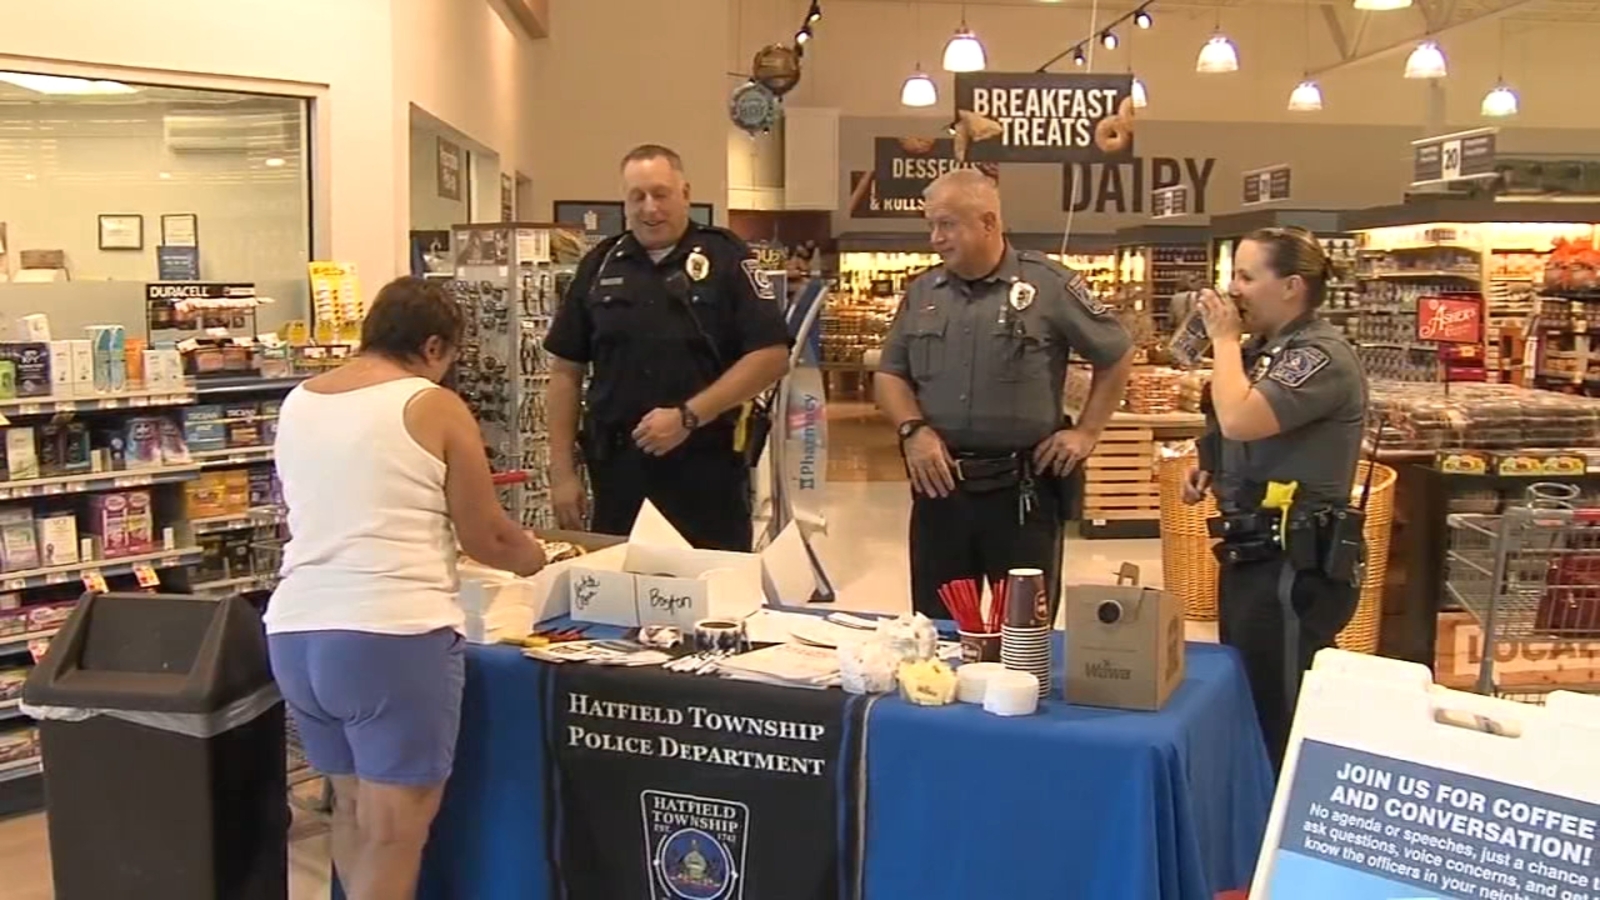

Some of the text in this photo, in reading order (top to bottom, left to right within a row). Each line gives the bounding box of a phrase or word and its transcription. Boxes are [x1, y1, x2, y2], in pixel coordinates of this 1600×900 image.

[973, 88, 1117, 117] BREAKFAST
[1002, 117, 1091, 147] TREATS
[1061, 158, 1216, 214] DAIRY
[149, 285, 210, 298] DURACELL
[800, 394, 817, 474] Pharmacy
[1084, 661, 1132, 681] Wawa
[568, 692, 825, 742] HATFIELD TOWNSHIP
[567, 726, 826, 776] POLICE DEPARTMENT
[651, 809, 739, 833] TOWNSHIP
[653, 796, 736, 819] HATFIELD
[1329, 784, 1593, 866] AND CONVERSATION!
[1336, 762, 1597, 840] JOIN US FOR COFFEE
[1303, 820, 1327, 836] ask
[1329, 827, 1400, 858] questions,
[1404, 846, 1443, 867] voice
[1445, 858, 1521, 890] concerns,
[1525, 880, 1558, 898] and
[1304, 835, 1341, 857] know
[1342, 846, 1366, 863] the
[1366, 855, 1421, 880] officers
[1423, 868, 1439, 884] in
[1440, 875, 1478, 895] your
[1309, 802, 1329, 819] No
[1331, 810, 1382, 833] agenda
[1385, 824, 1401, 837] or
[1403, 828, 1477, 860] speeches,
[1480, 846, 1511, 867] just
[1513, 858, 1524, 870] a
[1527, 861, 1589, 887] chance
